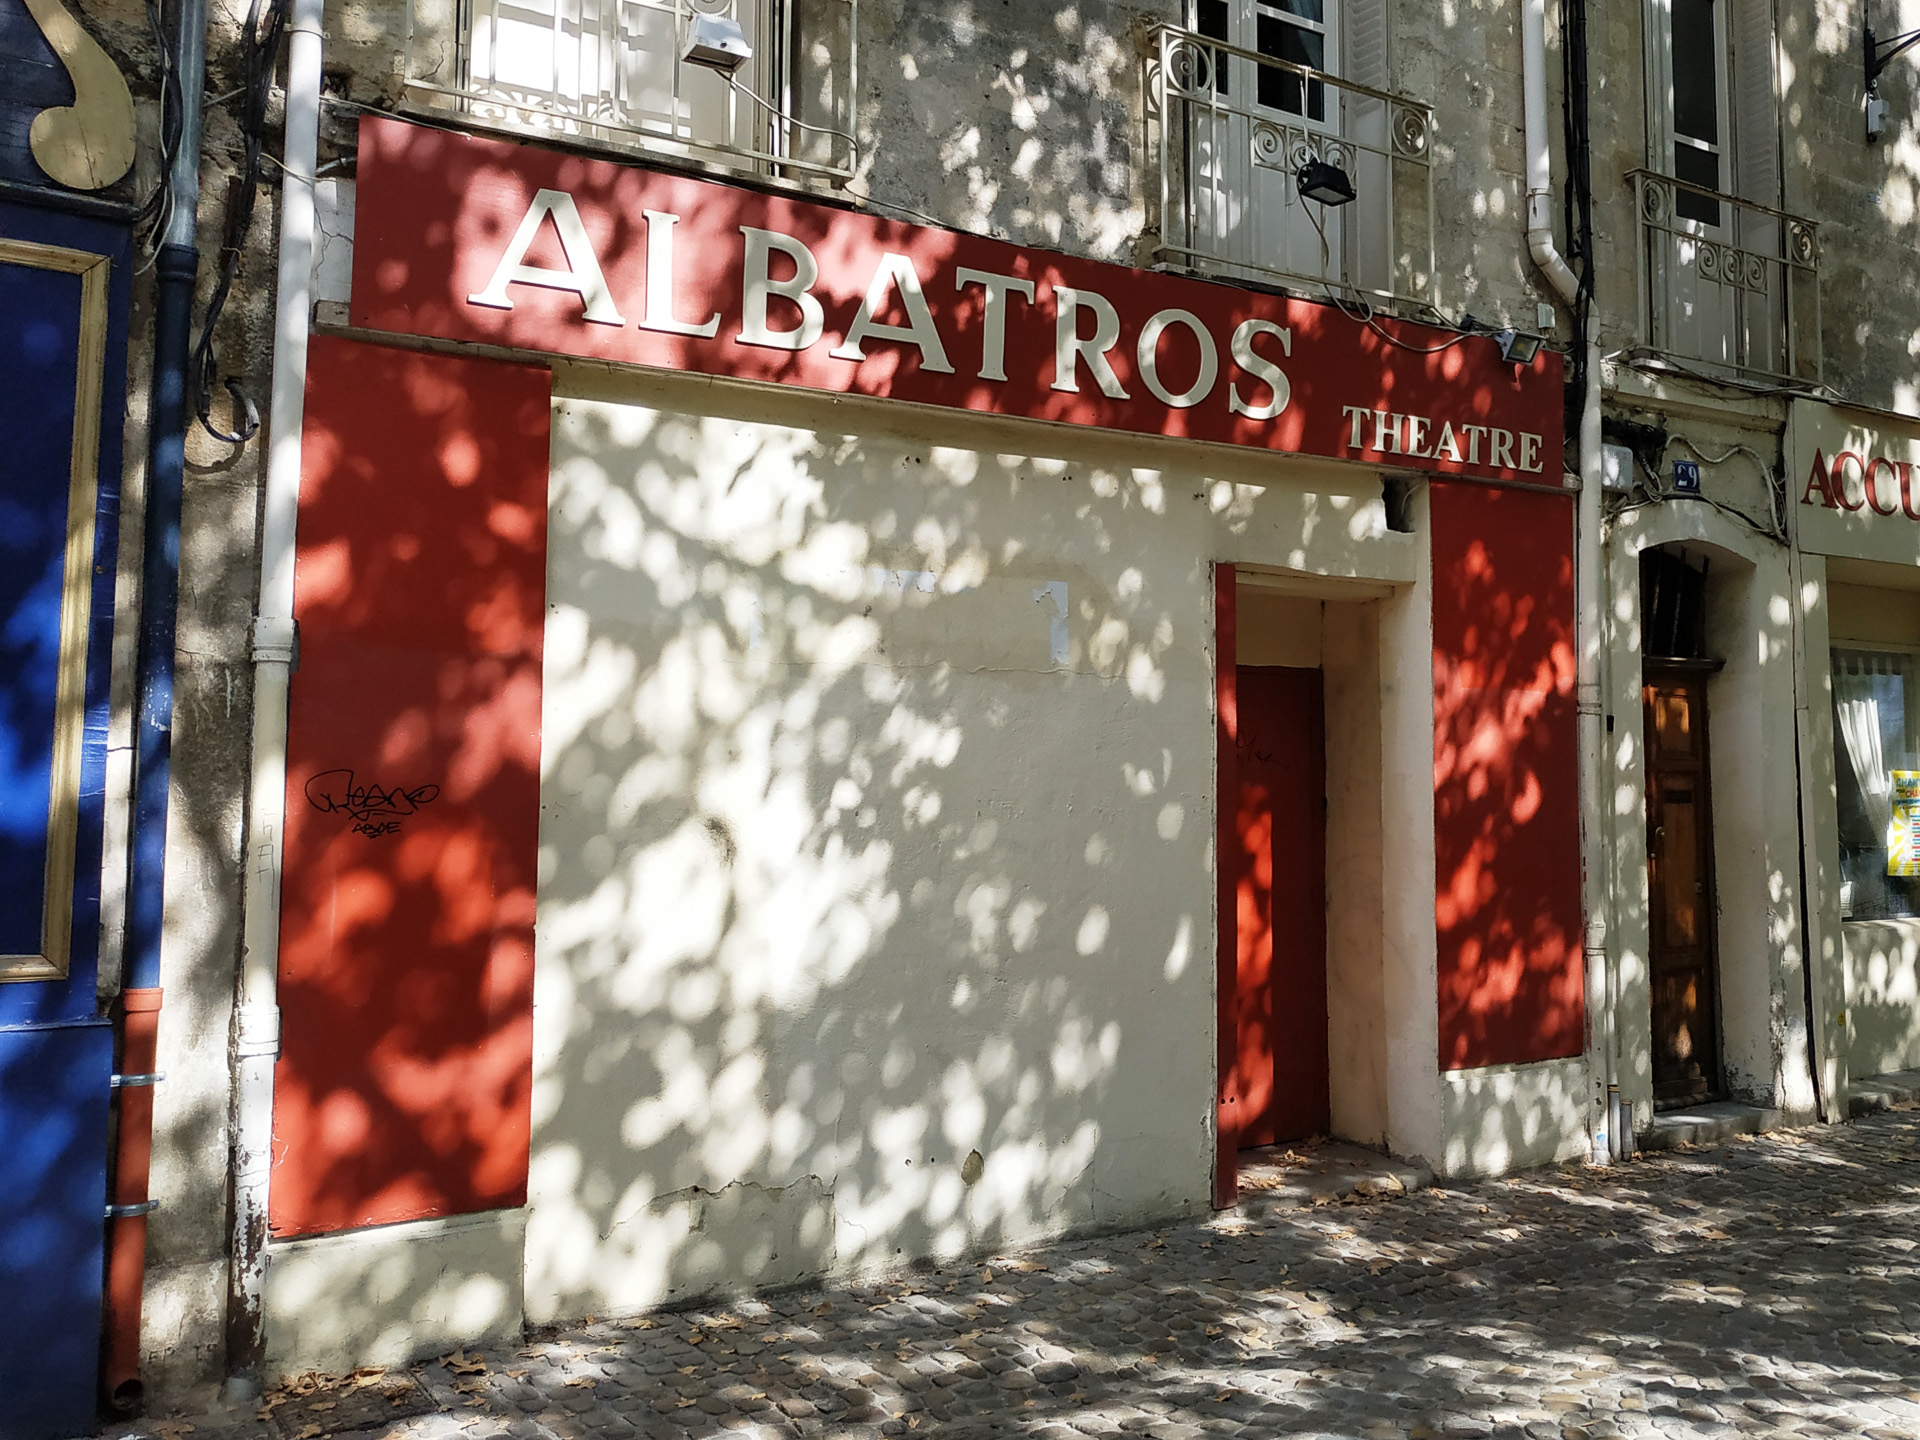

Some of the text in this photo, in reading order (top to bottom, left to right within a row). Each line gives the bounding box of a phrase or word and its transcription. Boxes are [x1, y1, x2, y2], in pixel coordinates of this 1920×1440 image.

[467, 188, 1292, 421] ALBATROS
[1342, 405, 1544, 474] THEATRE
[1677, 464, 1698, 488] 29
